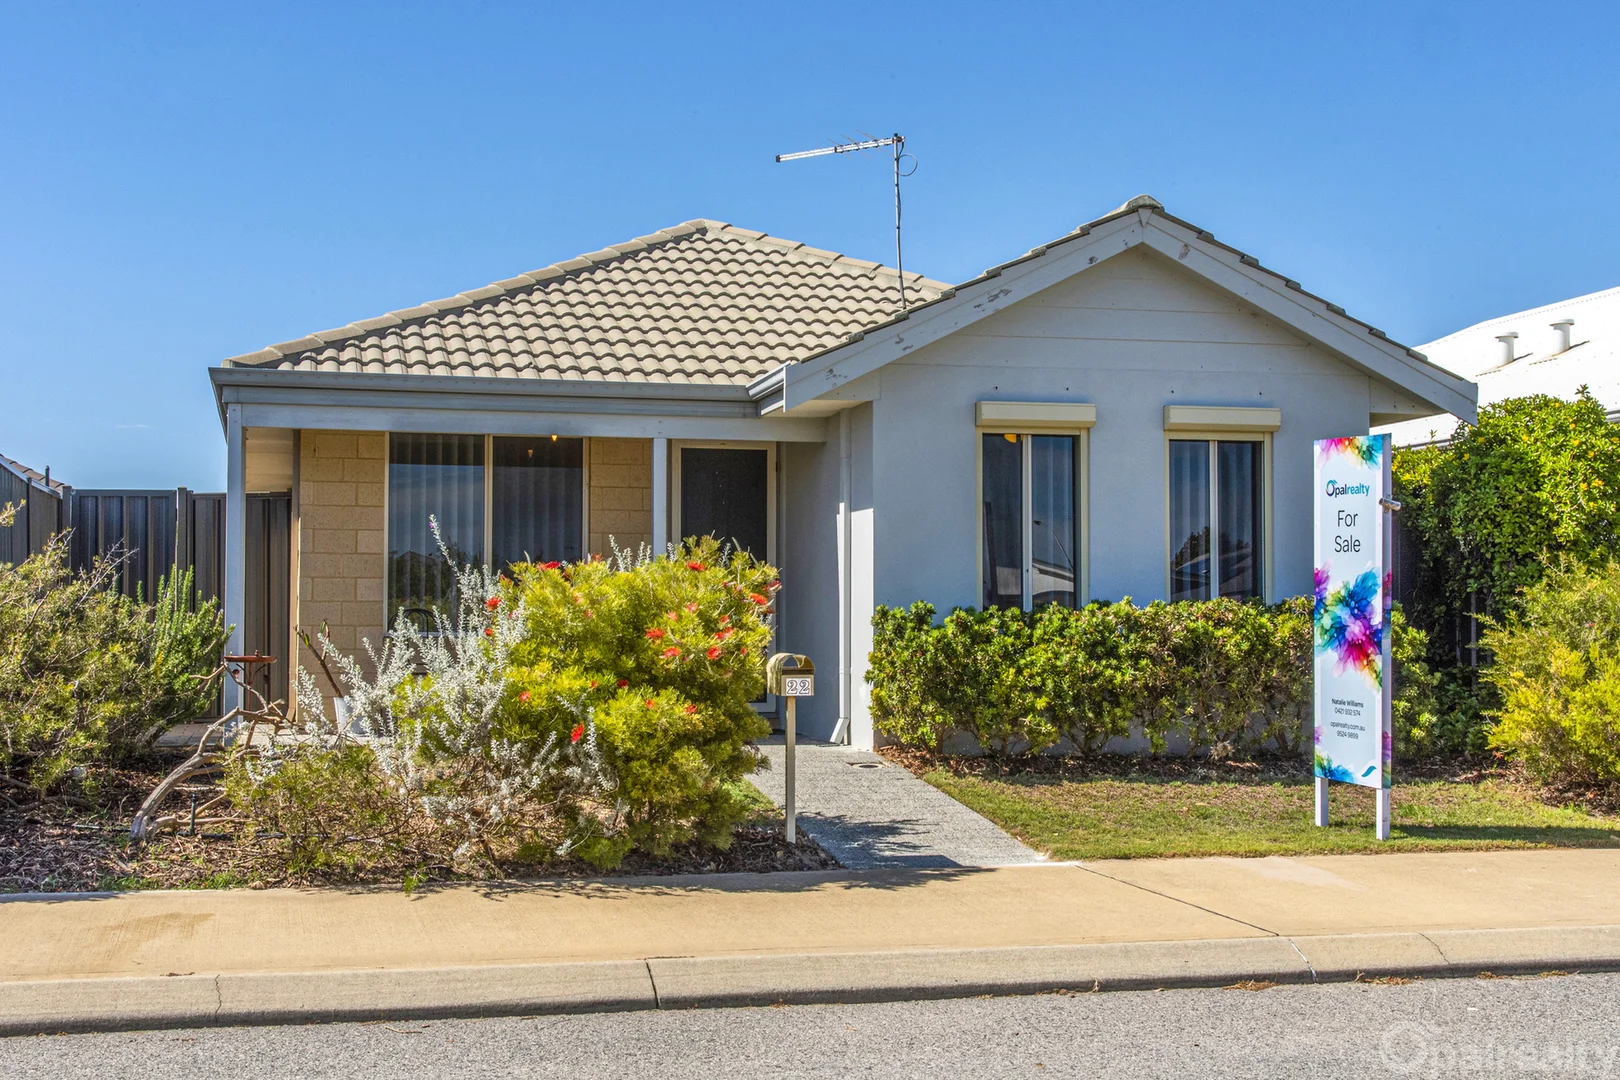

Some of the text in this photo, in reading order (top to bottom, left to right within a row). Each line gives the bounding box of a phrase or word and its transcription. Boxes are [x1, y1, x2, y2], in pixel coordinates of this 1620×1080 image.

[1326, 479, 1370, 498] Opalrealty
[1337, 509, 1358, 527] For
[1334, 534, 1361, 553] Sale
[786, 679, 811, 695] 22
[1331, 698, 1364, 708] Natalie Williams
[1334, 707, 1344, 715] 0421
[1330, 721, 1366, 731] opalrealty.com.au
